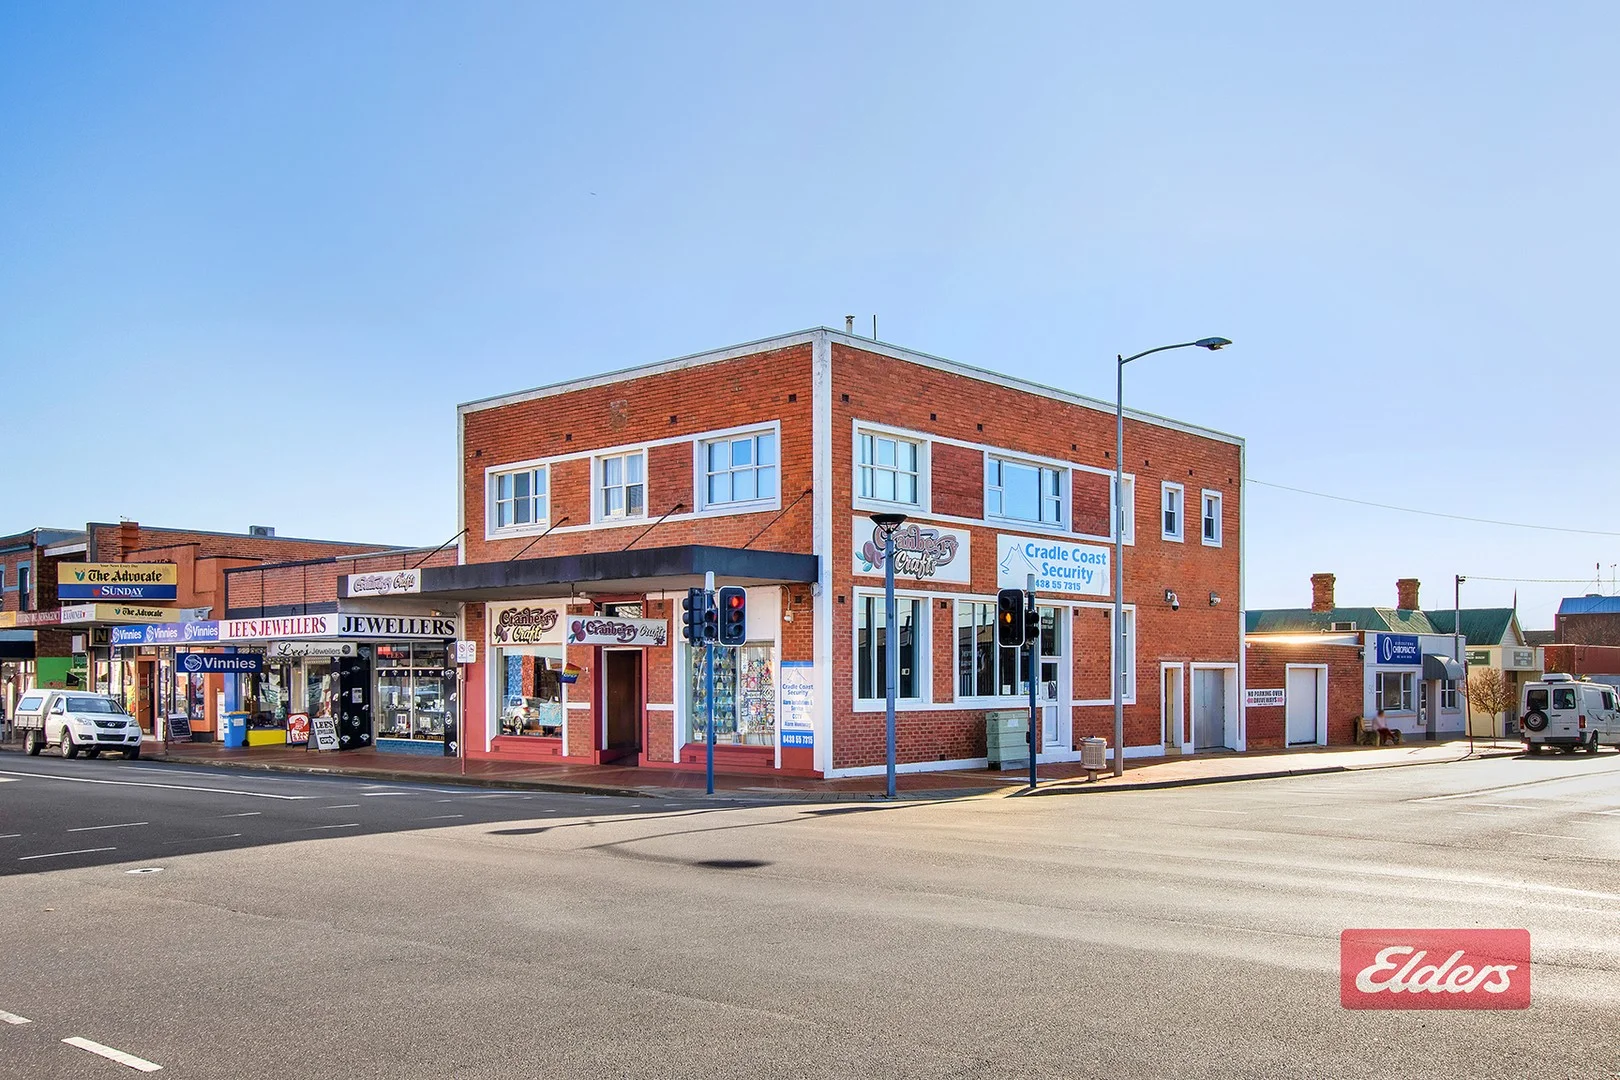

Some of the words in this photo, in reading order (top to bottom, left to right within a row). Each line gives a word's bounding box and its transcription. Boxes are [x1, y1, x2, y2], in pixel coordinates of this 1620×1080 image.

[1025, 543, 1069, 561] Cradle
[1072, 548, 1107, 565] Coast
[894, 549, 938, 580] Crafts
[88, 569, 110, 582] The
[111, 570, 163, 583] Advocate
[1041, 562, 1094, 585] Security
[101, 585, 143, 596] SUNDAY
[1051, 580, 1062, 589] 55
[1063, 581, 1081, 591] 7315
[122, 608, 134, 616] The
[135, 609, 163, 617] Advocate
[229, 620, 257, 638] LEE'S
[258, 616, 326, 636] JEWELLERS
[342, 616, 455, 636] JEWELLERS
[500, 607, 559, 634] Cranberry
[96, 629, 107, 642] N
[119, 628, 142, 640] Vinnies
[153, 626, 178, 639] Vinnies
[191, 624, 218, 637] Vinnies
[512, 625, 543, 644] Crafts
[585, 620, 638, 643] Cranberry
[277, 641, 310, 656] Lee's
[203, 657, 257, 669] Vinnies
